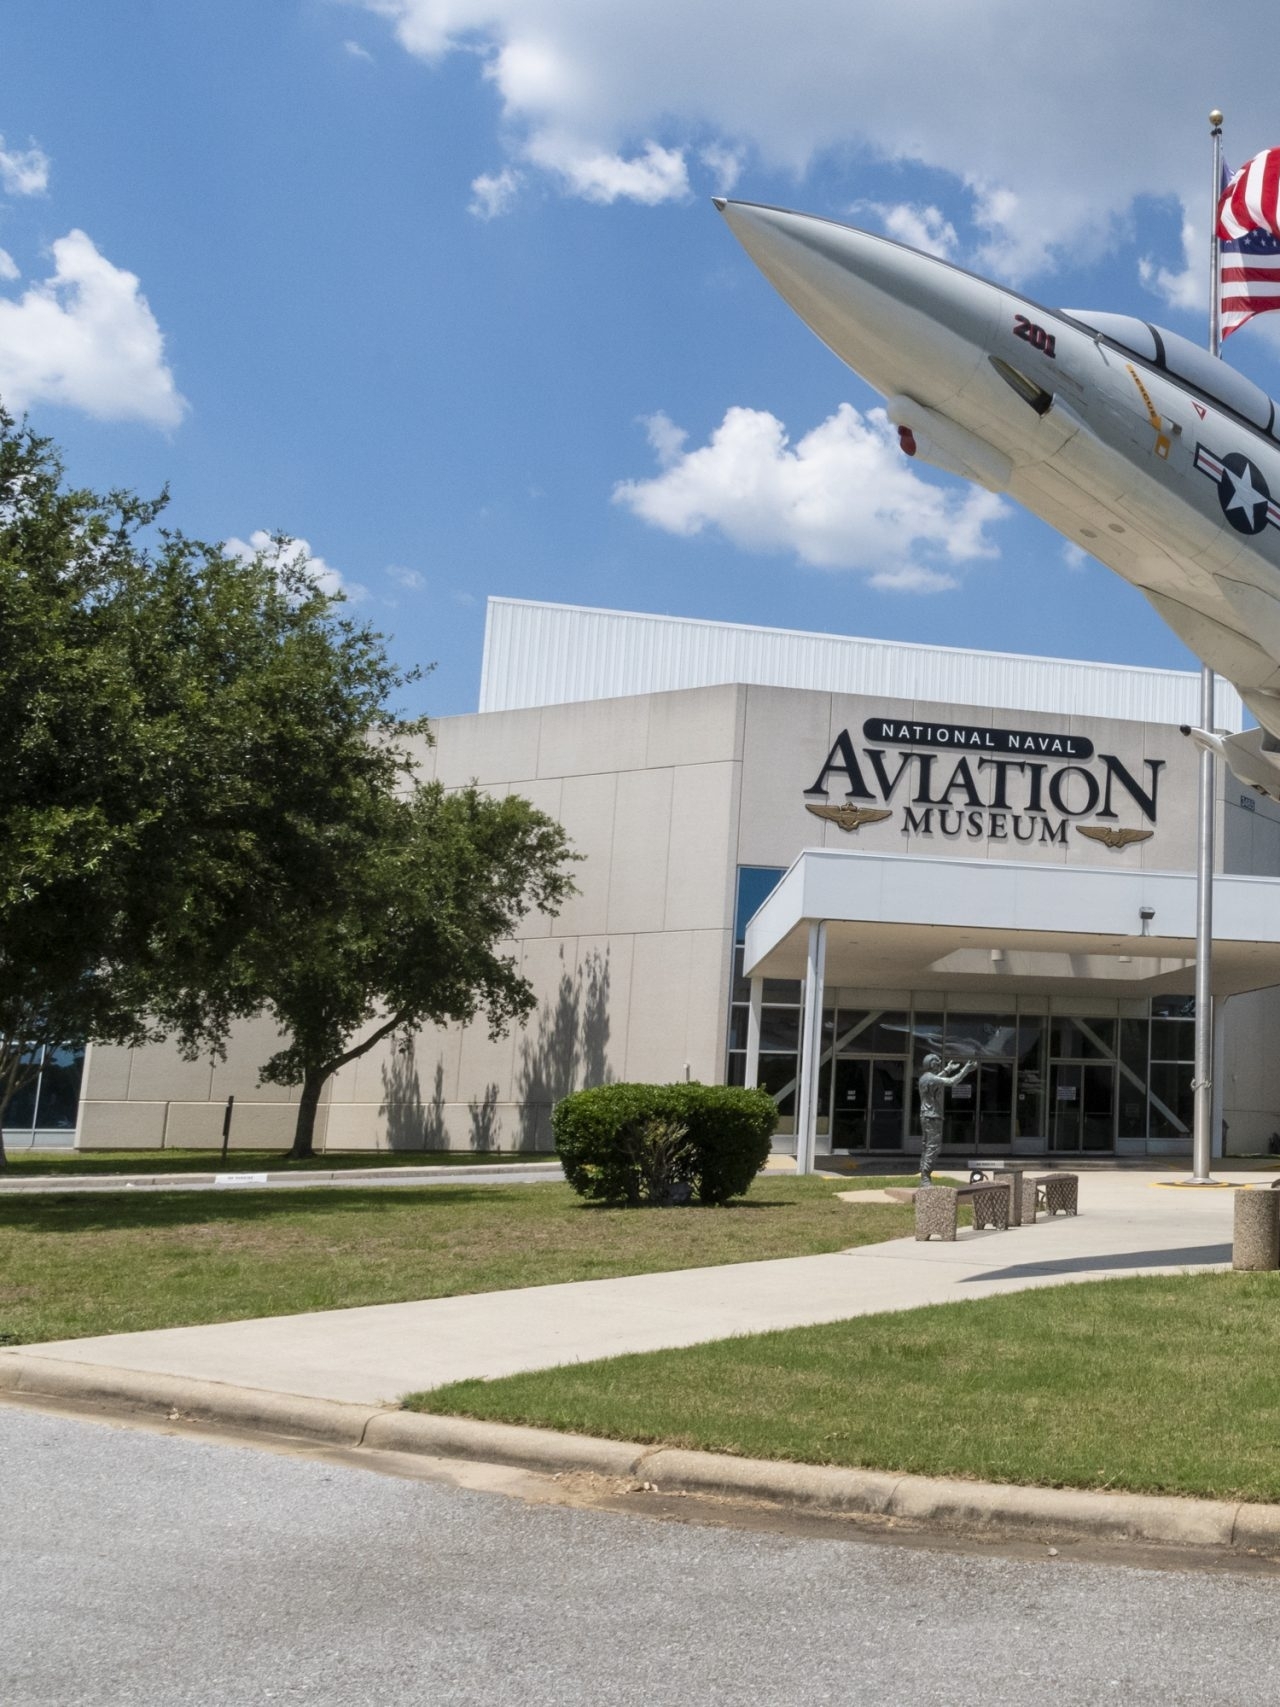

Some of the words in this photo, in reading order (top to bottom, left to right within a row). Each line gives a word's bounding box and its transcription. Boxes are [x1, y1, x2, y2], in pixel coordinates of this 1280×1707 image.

[1013, 314, 1056, 359] 201
[1130, 370, 1158, 418] RESCUE
[882, 723, 995, 746] NATIONAL
[1008, 735, 1077, 754] NAVAL
[803, 728, 1166, 823] AVIATION
[901, 806, 1070, 844] MUSEUM
